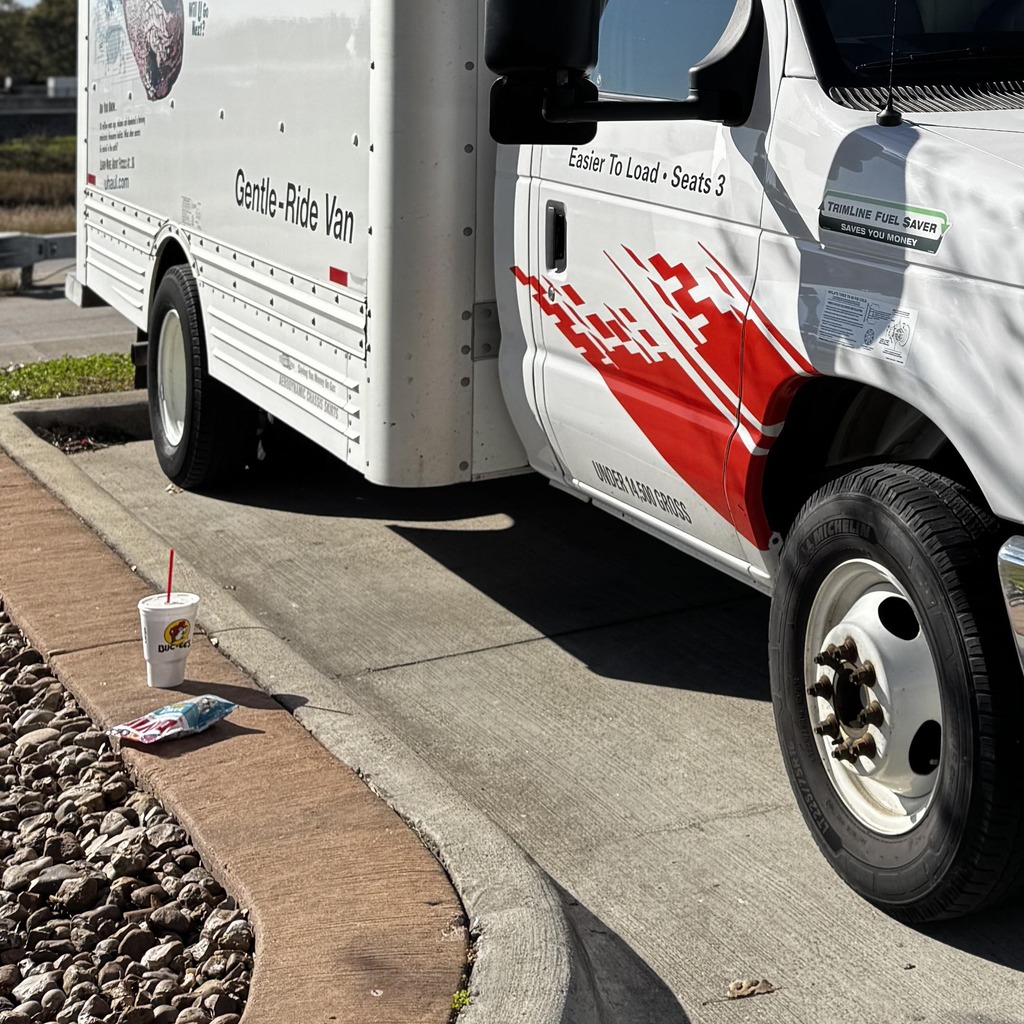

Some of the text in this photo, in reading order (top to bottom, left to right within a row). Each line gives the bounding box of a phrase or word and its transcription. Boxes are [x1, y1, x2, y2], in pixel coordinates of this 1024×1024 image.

[104, 174, 129, 190] uhaul.com
[568, 147, 725, 196] Easier To Load Seats 3
[235, 168, 319, 231] Gentle-Ride
[325, 193, 354, 244] Van
[827, 201, 937, 233] TRIMLINE FUEL SAVER
[841, 223, 918, 247] SAVES YOU MONEY
[592, 460, 629, 494] UNDER
[654, 488, 692, 524] GROSS
[813, 519, 870, 545] MICHELIN
